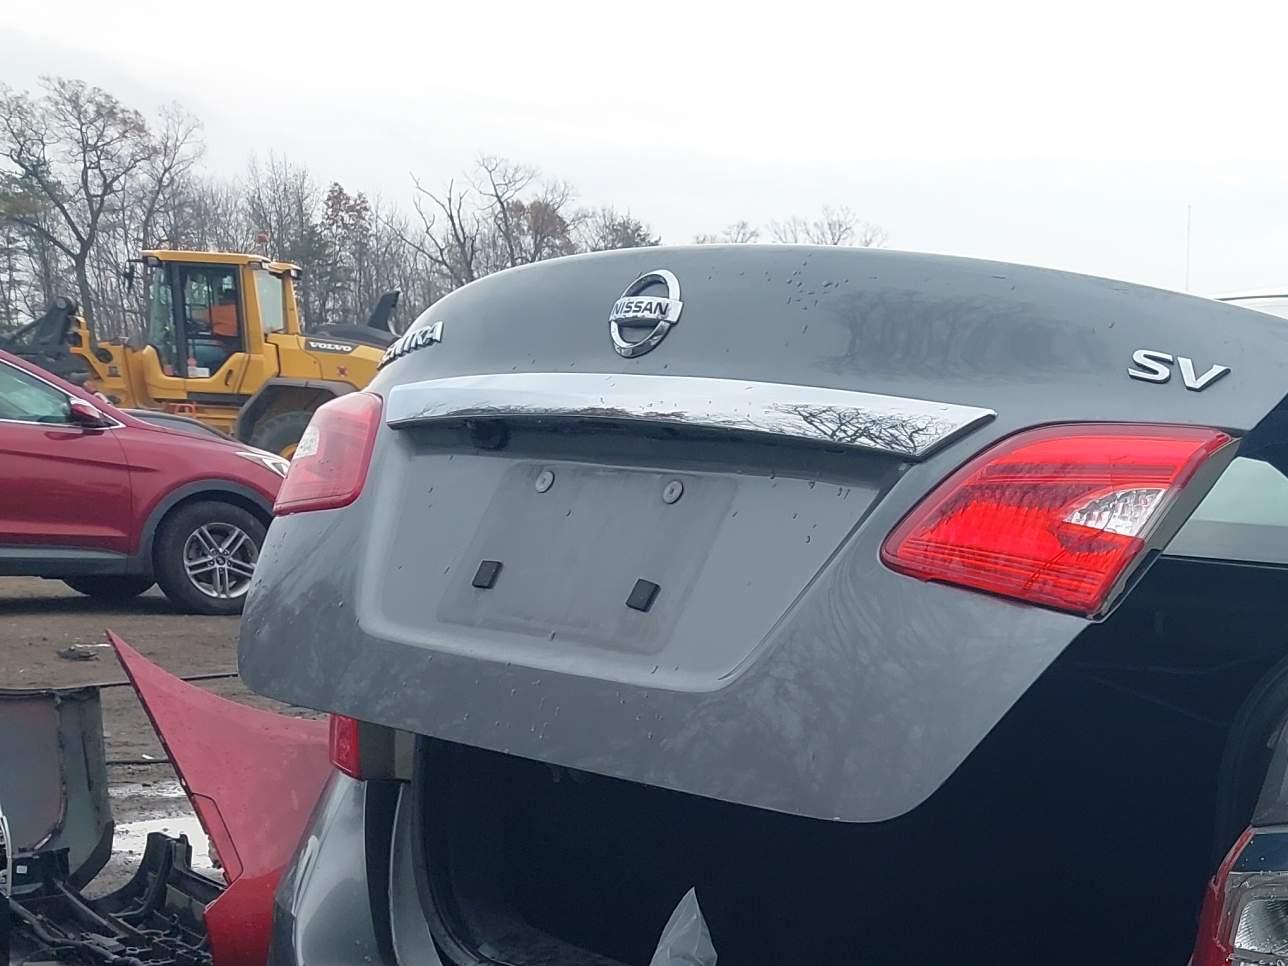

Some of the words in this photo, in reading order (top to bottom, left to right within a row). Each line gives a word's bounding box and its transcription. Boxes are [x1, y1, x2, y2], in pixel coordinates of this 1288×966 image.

[614, 300, 670, 316] NISSAN
[308, 341, 353, 352] VOLVO
[1127, 348, 1231, 392] SV
